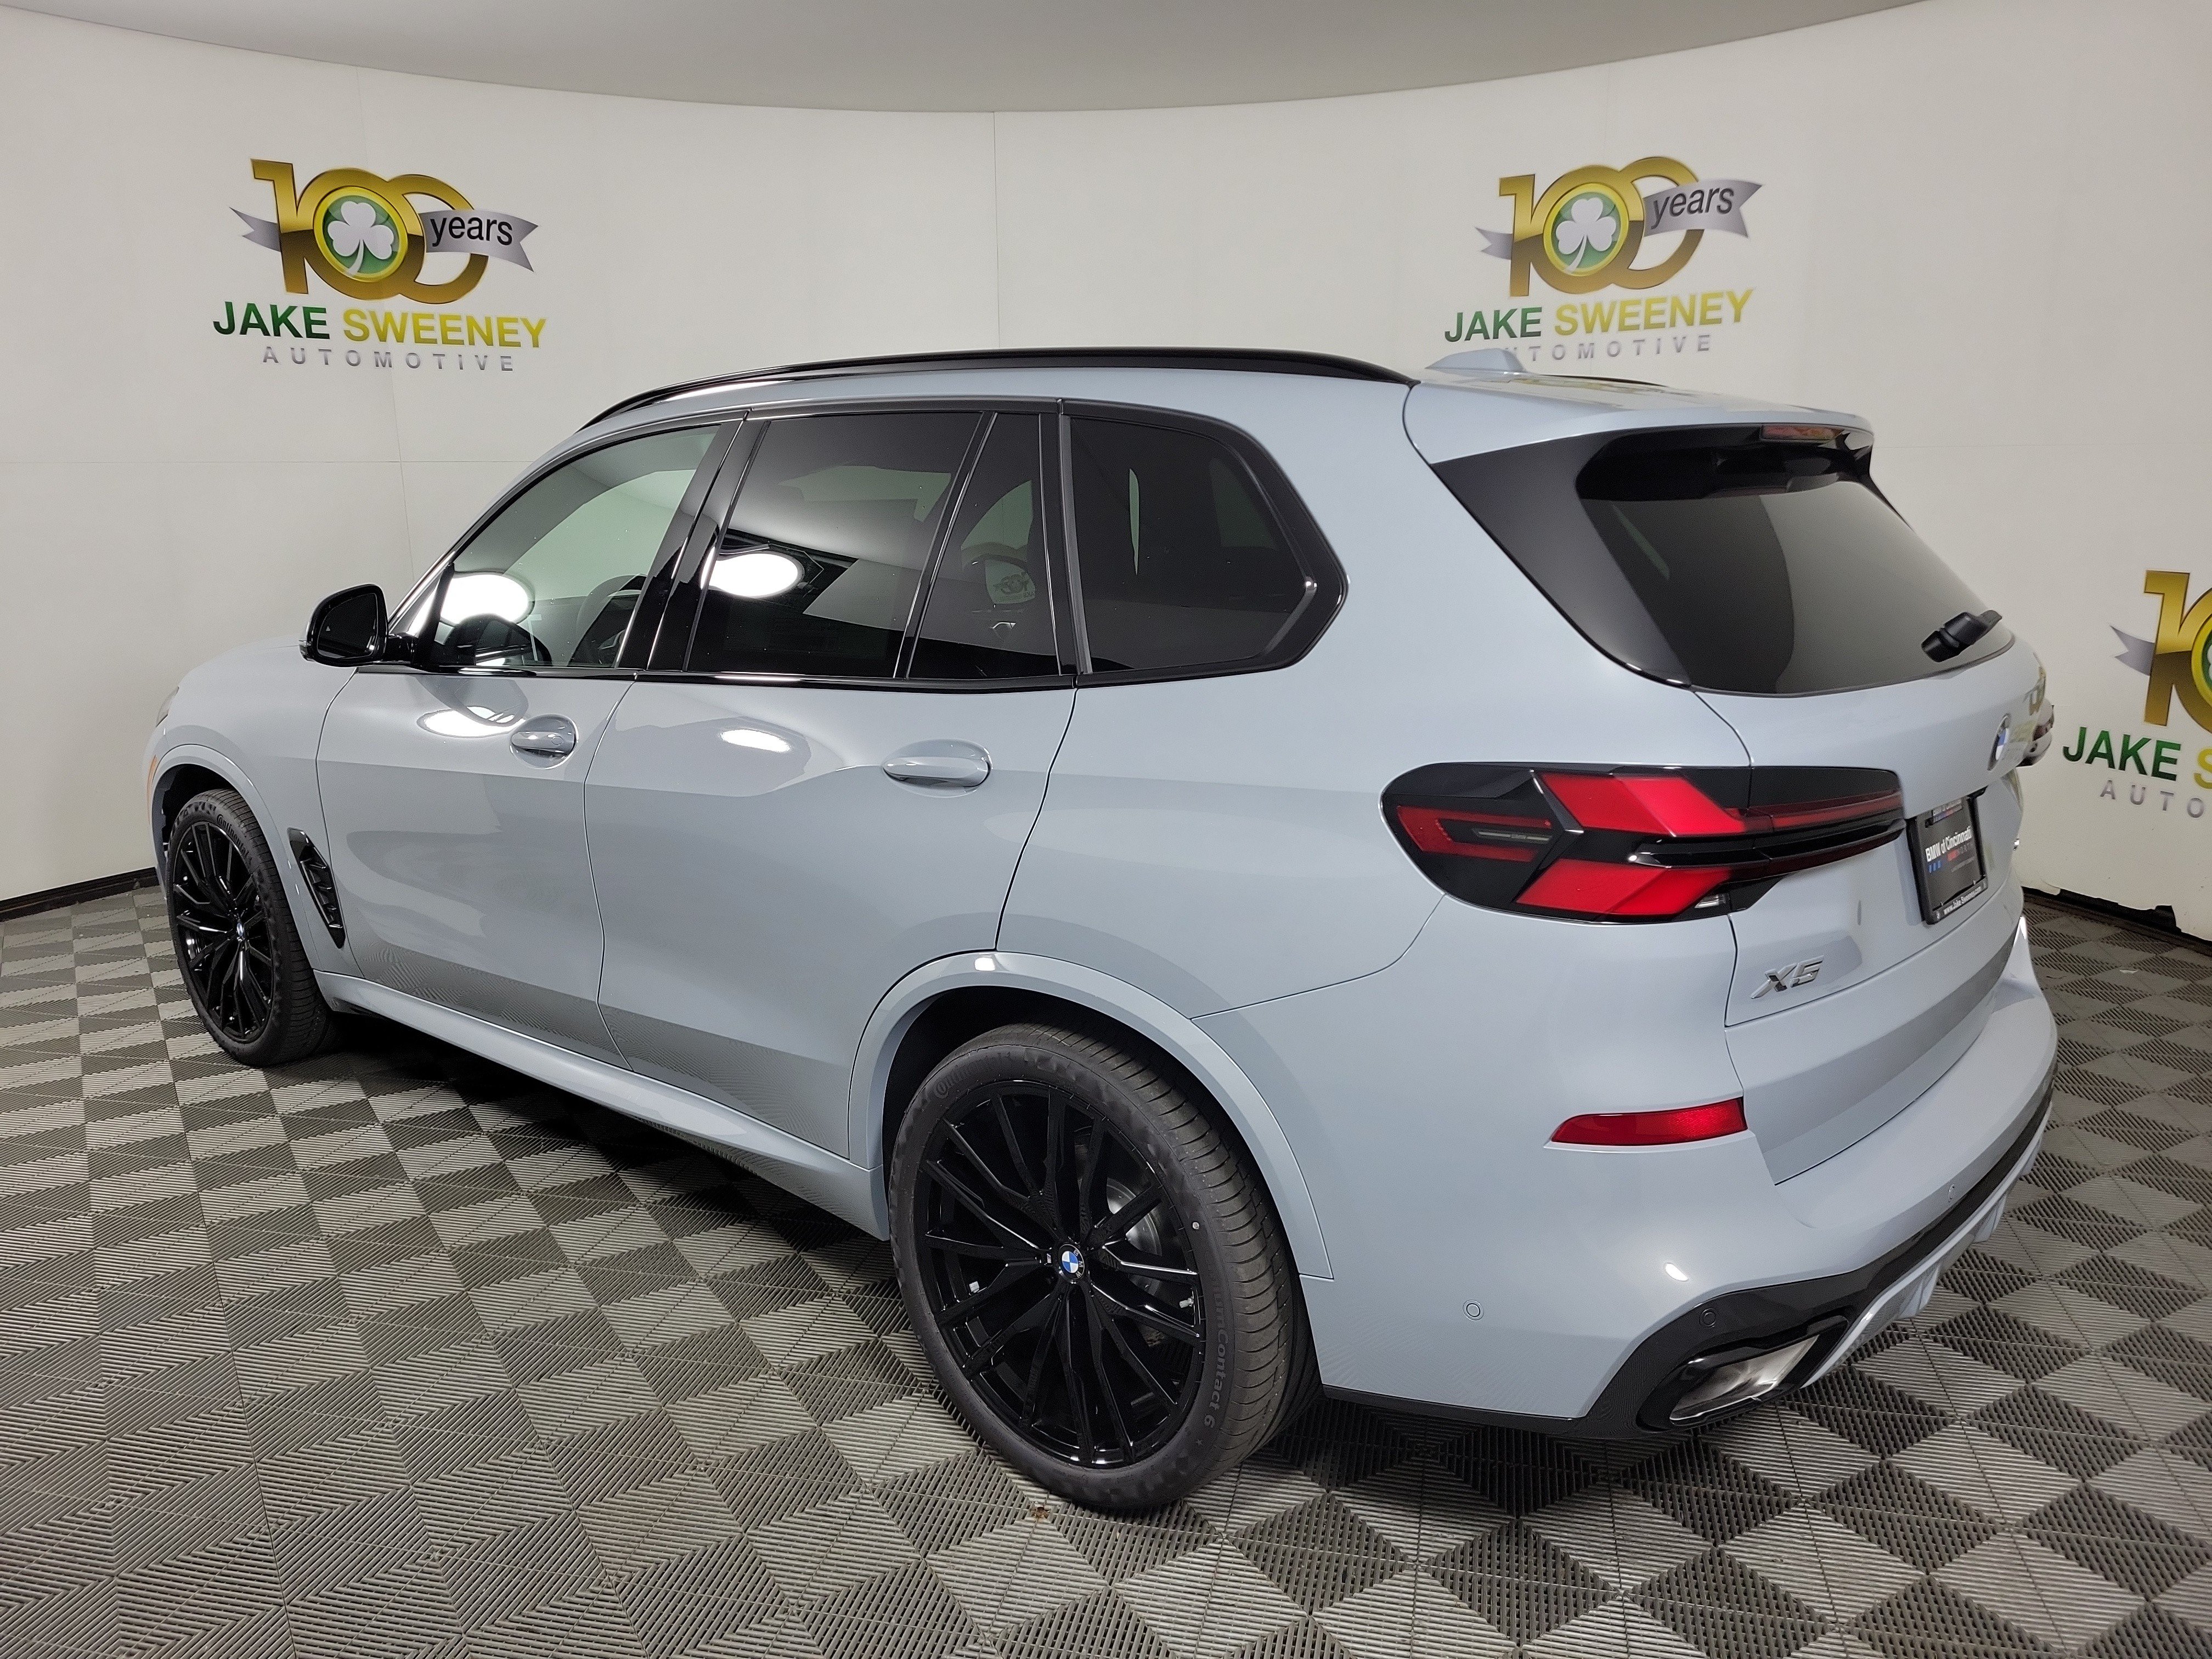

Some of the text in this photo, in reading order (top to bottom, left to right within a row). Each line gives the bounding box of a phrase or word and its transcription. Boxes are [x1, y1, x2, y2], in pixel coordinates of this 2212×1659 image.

[1499, 156, 1705, 297] 100
[1651, 186, 1735, 229] years
[250, 158, 489, 305] 100
[430, 216, 514, 246] years
[213, 301, 547, 348] JAKE SWEENEY
[1444, 289, 1753, 343] JAKE SWEENEY
[262, 346, 514, 371] AUTOMOTIVE
[1504, 334, 1711, 362] TOMOTIVE
[2063, 726, 2182, 782] JAKE
[1925, 842, 1941, 862] BMW
[1945, 826, 1972, 850] Cincinnati
[1750, 955, 1824, 999] X5
[1074, 1249, 1085, 1278] BMW
[1204, 1414, 1216, 1428] 6
